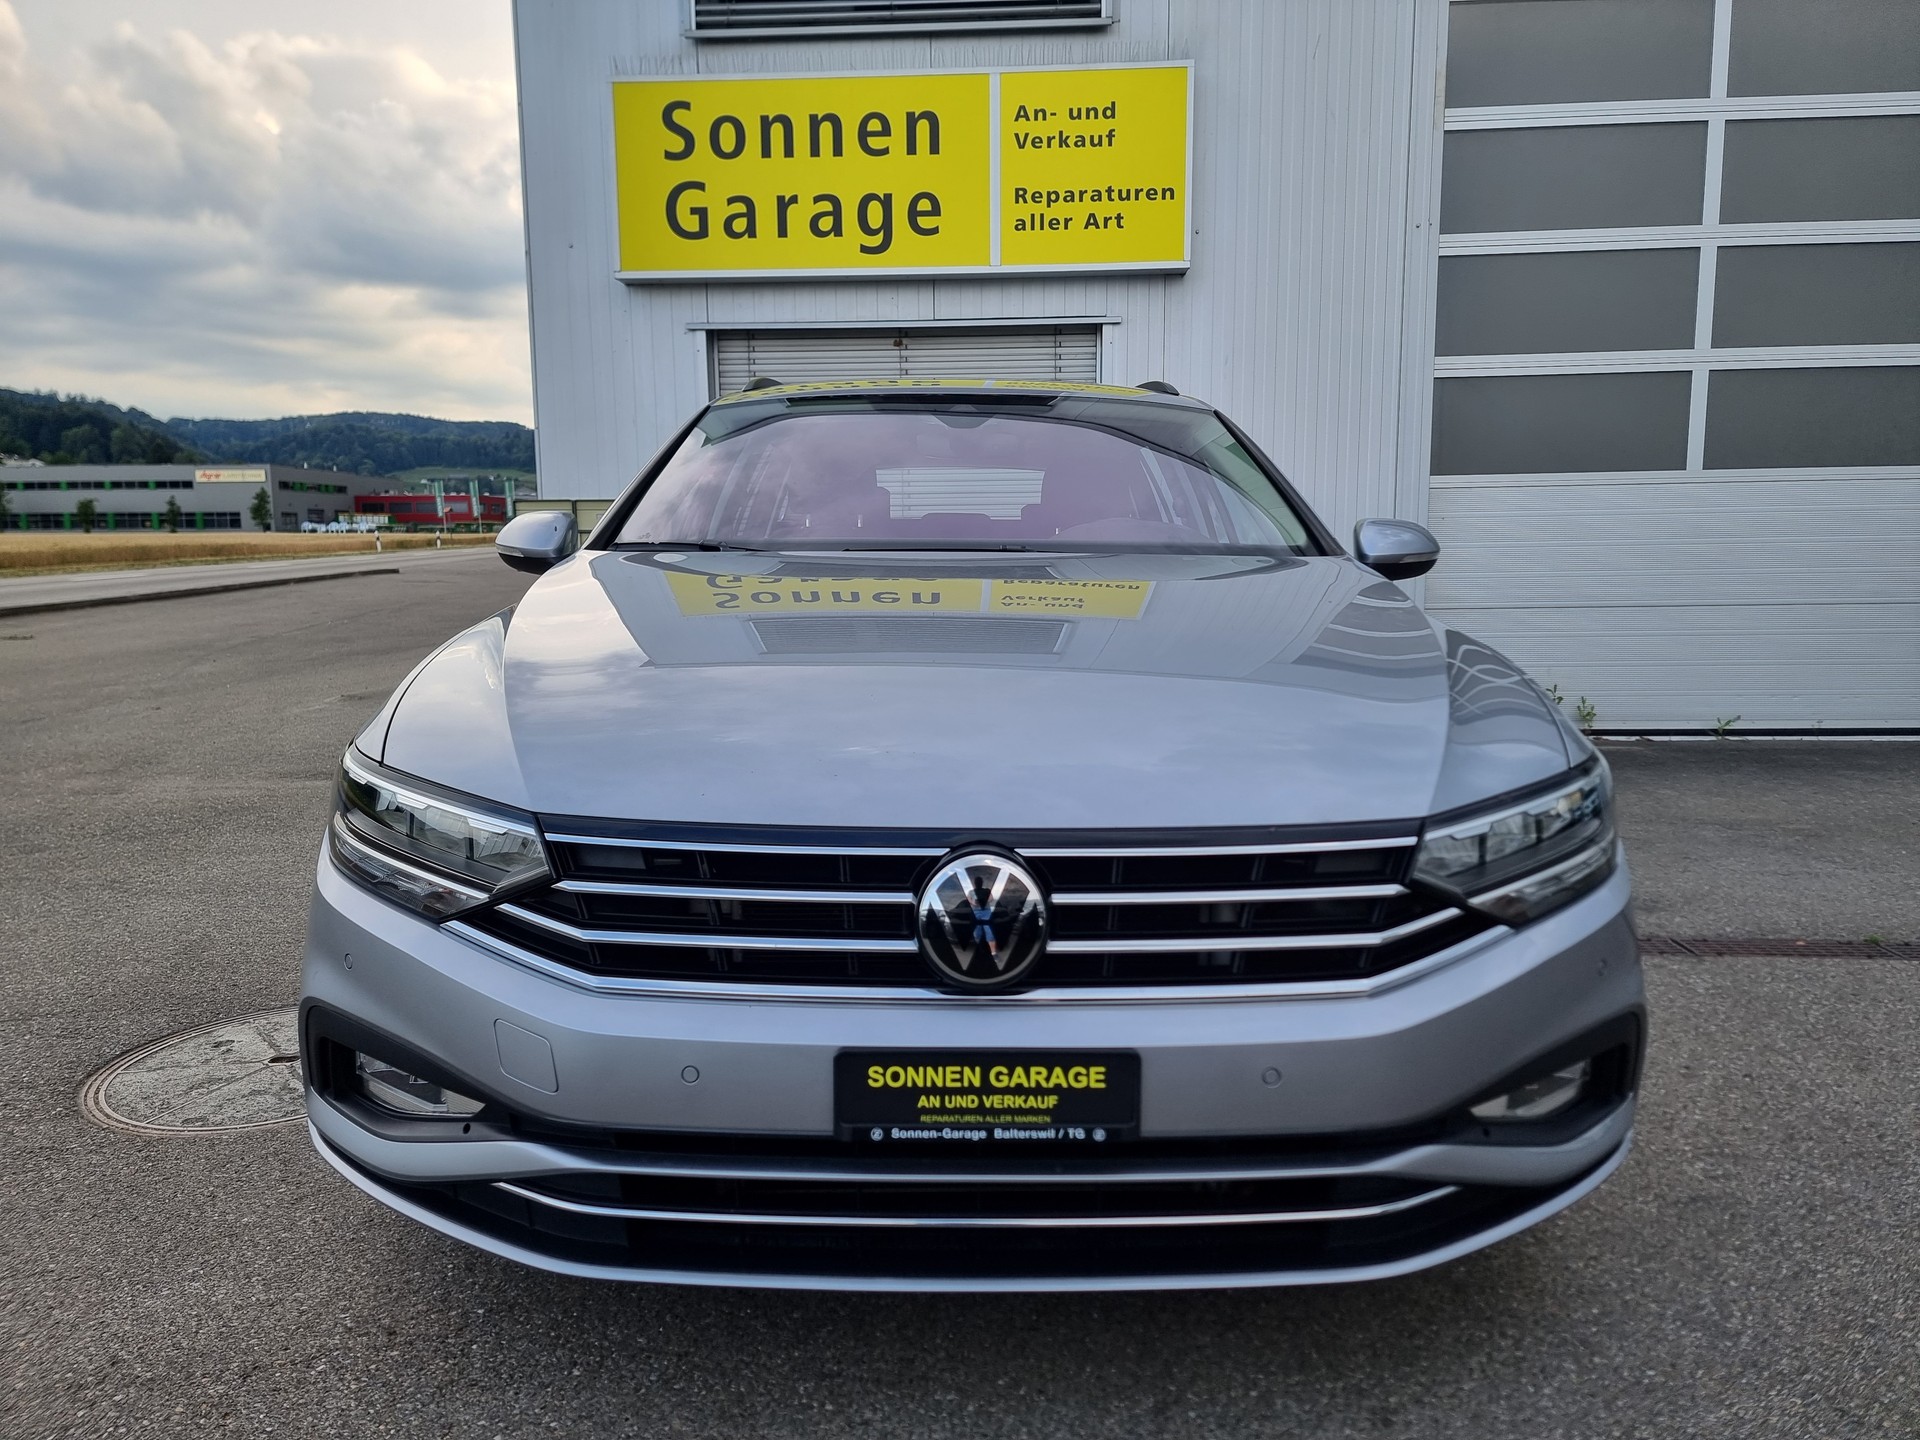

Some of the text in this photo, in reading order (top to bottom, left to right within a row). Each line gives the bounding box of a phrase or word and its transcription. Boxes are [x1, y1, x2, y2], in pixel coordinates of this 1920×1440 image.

[1013, 101, 1116, 123] An- und
[661, 100, 942, 161] Sonnen
[1013, 128, 1116, 150] Verkauf
[1014, 185, 1176, 208] Reparaturen
[664, 180, 942, 256] Garage
[1013, 211, 1125, 233] aller Art
[867, 1065, 1107, 1089] SONNEN GARAGE
[917, 1095, 1059, 1109] AN UND VERKAUF
[920, 1113, 1051, 1124] REPARATUREN ALLER MARKEN
[890, 1127, 987, 1141] Sonnen-Garage
[1067, 1127, 1086, 1140] TG
